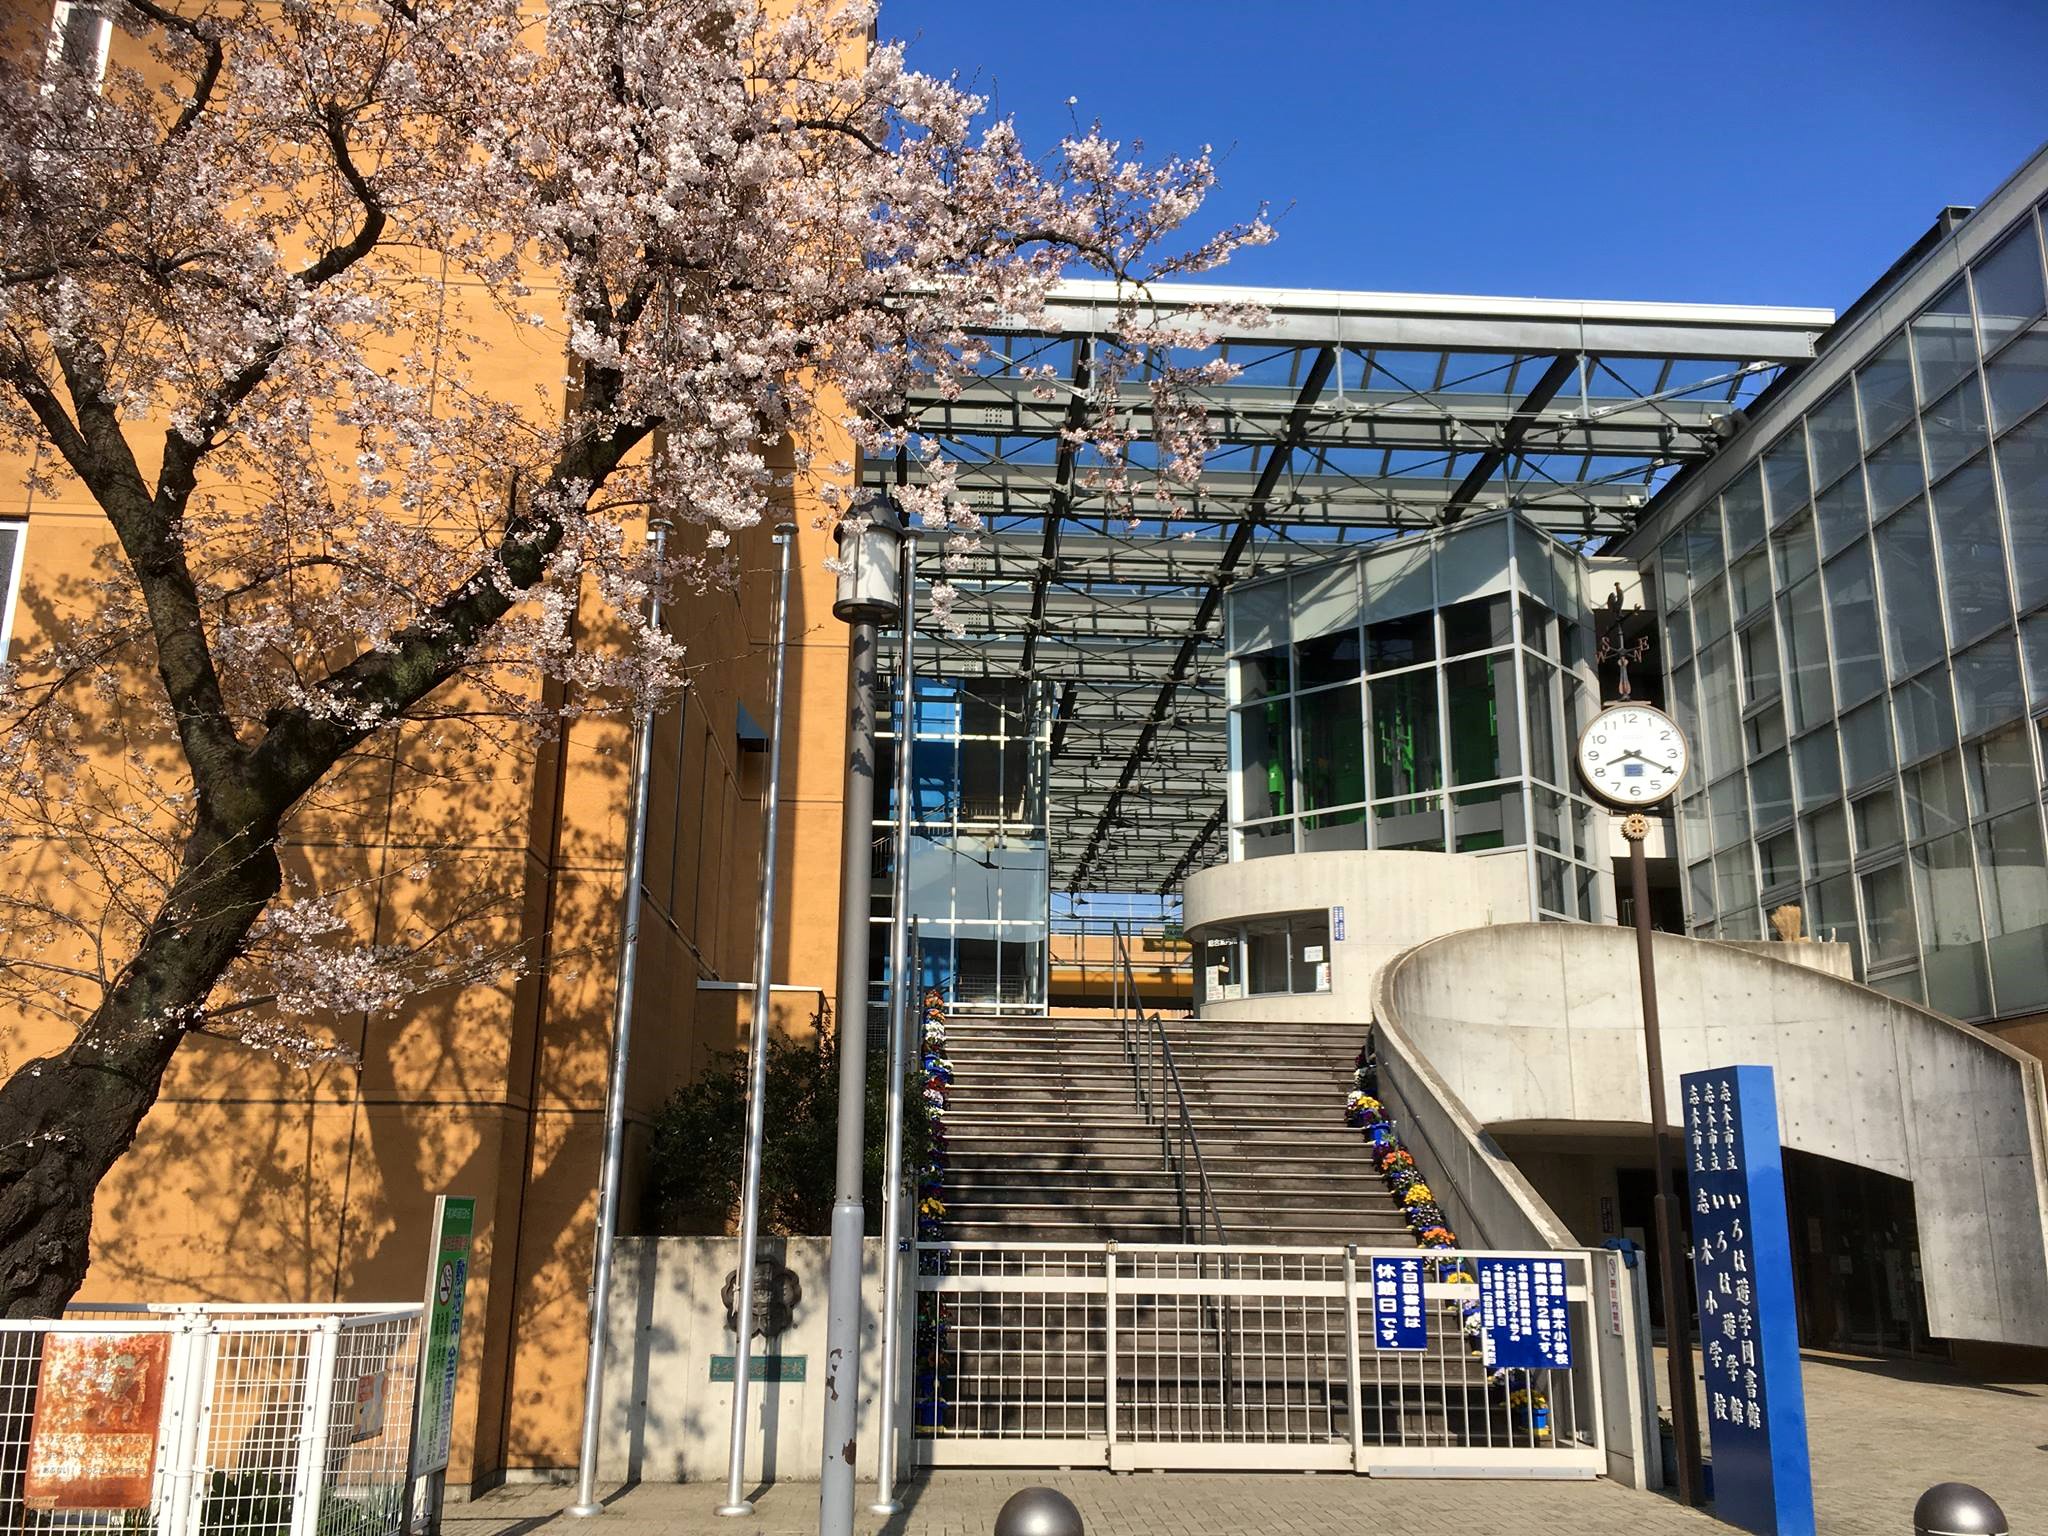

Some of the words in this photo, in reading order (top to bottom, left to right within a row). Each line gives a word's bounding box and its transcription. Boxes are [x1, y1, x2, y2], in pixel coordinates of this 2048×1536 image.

[1623, 713, 1638, 724] 12
[1604, 721, 1617, 730] 11
[1592, 735, 1607, 745] 10
[1660, 730, 1671, 741] 2
[1588, 750, 1600, 761] 9
[1666, 748, 1678, 759] 3
[1594, 767, 1606, 778] 8
[1611, 782, 1621, 792] 7
[1650, 780, 1662, 790] 5
[1629, 786, 1641, 796] 6
[1689, 1084, 1706, 1172] 志木市立
[1704, 1082, 1722, 1171] 志木市立
[1720, 1080, 1738, 1171] 志木市立
[1401, 1260, 1421, 1328] 本日図書館は
[1376, 1263, 1399, 1347] 休館日です。
[1696, 1187, 1728, 1421] 志木小学校
